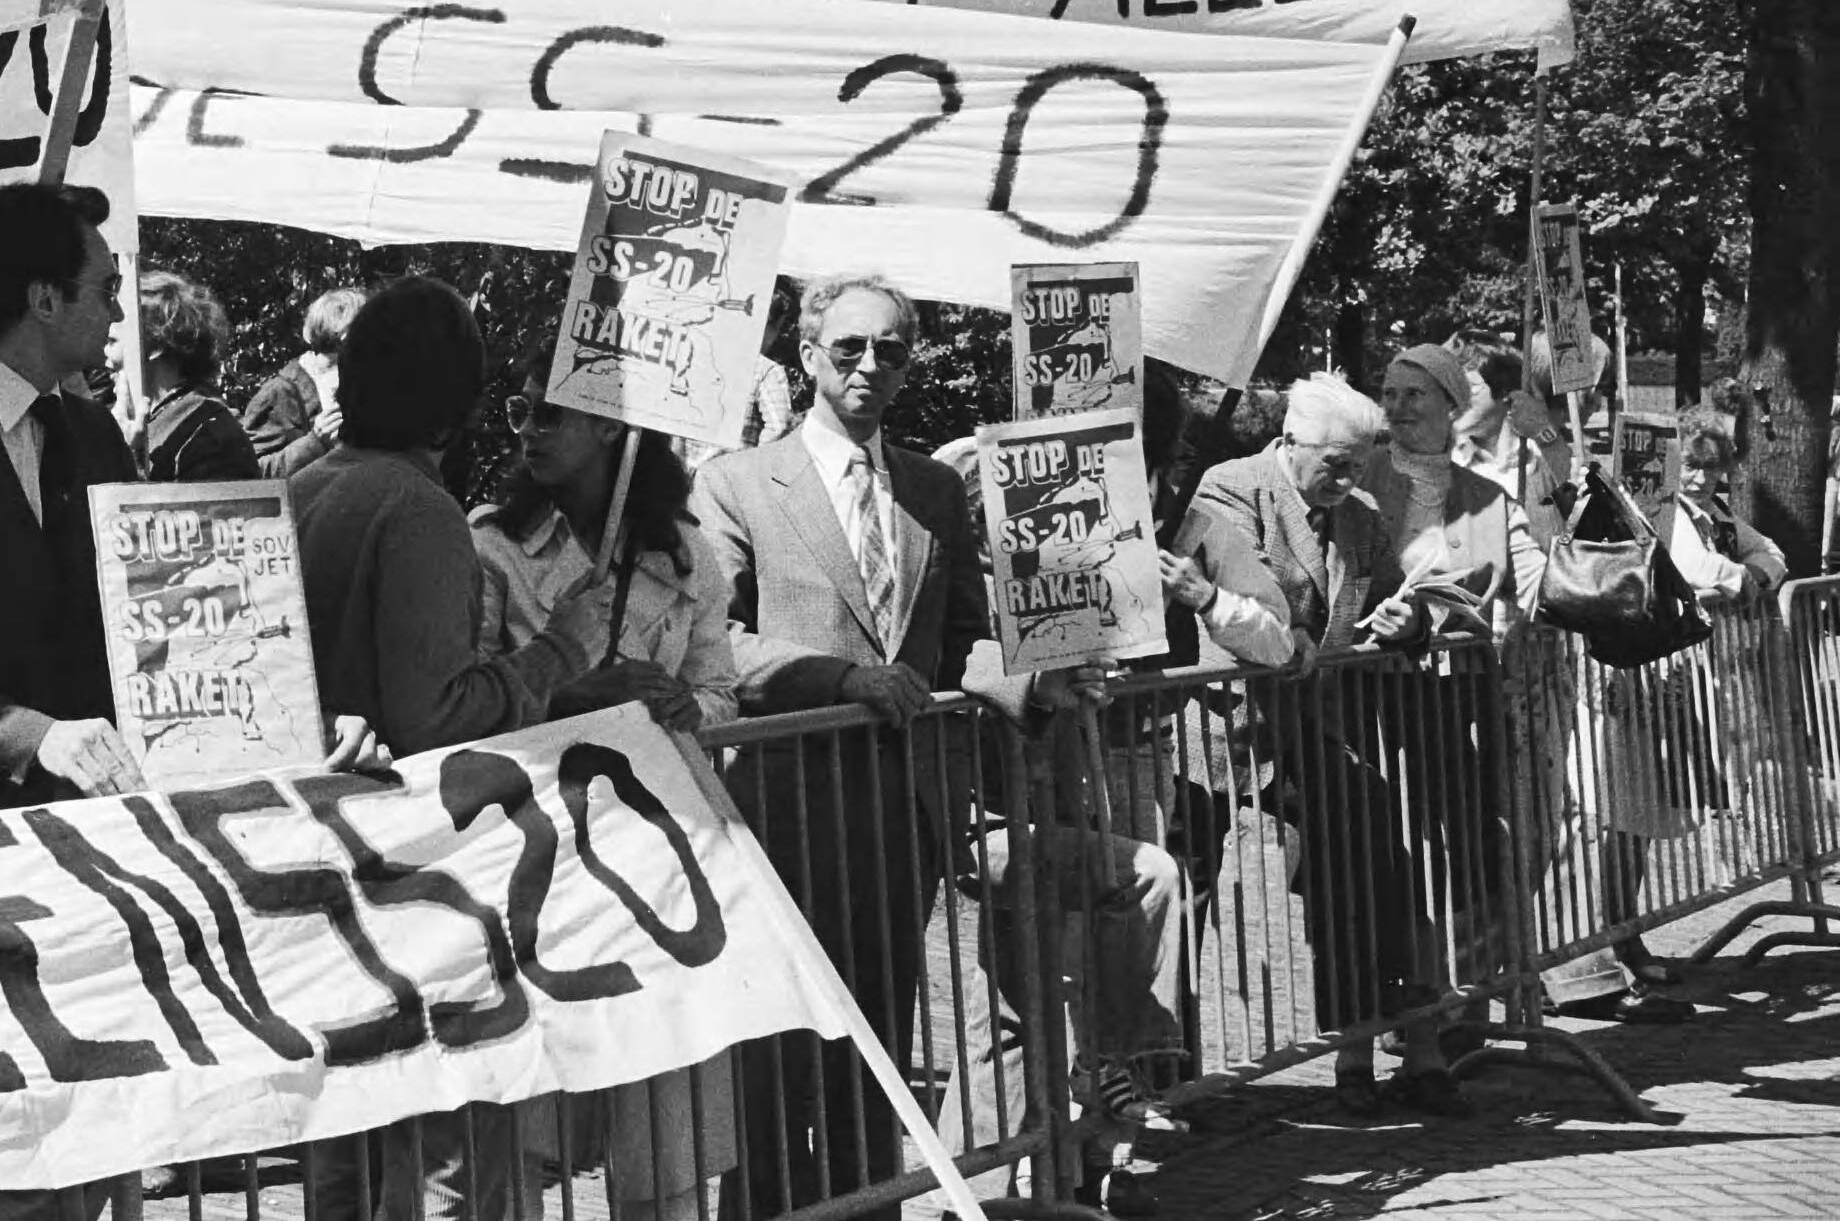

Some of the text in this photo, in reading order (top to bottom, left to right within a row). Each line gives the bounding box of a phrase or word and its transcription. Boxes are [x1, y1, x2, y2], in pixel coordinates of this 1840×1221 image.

[604, 156, 745, 230] STOP DE
[586, 234, 695, 293] SS-20
[1020, 287, 1111, 326] STOP DE
[571, 300, 690, 368] RAKET
[1022, 352, 1093, 387] SS-20
[990, 440, 1105, 488] STOP DE
[112, 509, 245, 563] STOP DE
[999, 510, 1088, 554] SS-20
[254, 556, 292, 576] JET
[1004, 568, 1102, 616] RAKET
[119, 597, 226, 642] SS-20
[126, 669, 244, 720] RAKET
